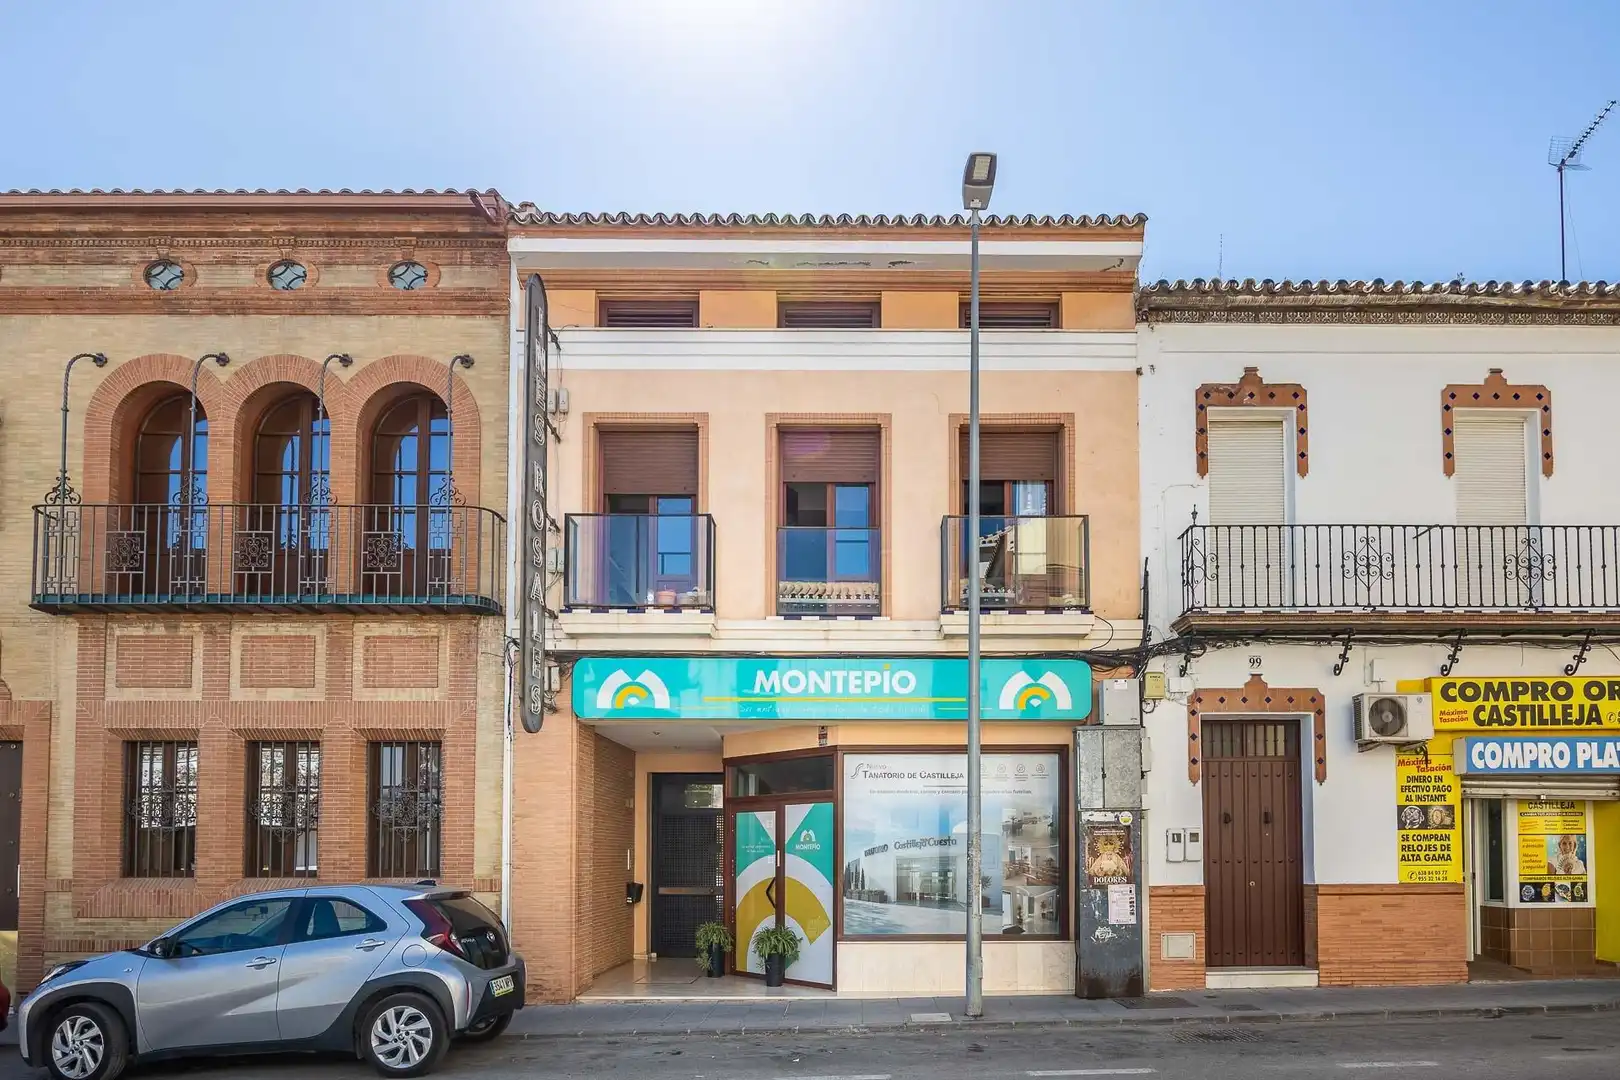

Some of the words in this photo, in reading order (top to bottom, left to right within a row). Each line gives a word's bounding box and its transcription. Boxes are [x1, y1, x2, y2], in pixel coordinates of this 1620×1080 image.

[530, 461, 545, 715] ROSALES
[1248, 657, 1262, 668] 99
[1440, 680, 1574, 703] COMPRO
[1472, 704, 1603, 727] CASTILLEJA
[1471, 742, 1571, 769] COMPRO
[1416, 764, 1452, 773] Tasación
[862, 770, 905, 780] TANATORIO
[907, 771, 917, 779] DE
[919, 770, 964, 780] CASTILLEJA
[1406, 775, 1433, 783] DINERO
[1434, 775, 1443, 783] EN
[1400, 785, 1431, 793] EFECTIVO
[1432, 784, 1452, 793] PAGO
[1404, 794, 1414, 802] AL
[1415, 794, 1447, 802] INSTANTE
[1527, 801, 1575, 810] CASTILLEJA
[927, 836, 957, 847] Cuesta
[1401, 834, 1410, 842] SE
[1412, 834, 1451, 842] COMPRAN
[1401, 844, 1438, 852] RELOJES
[1440, 844, 1452, 852] DE
[1400, 854, 1422, 862] ALTA
[1424, 854, 1452, 862] GAMA
